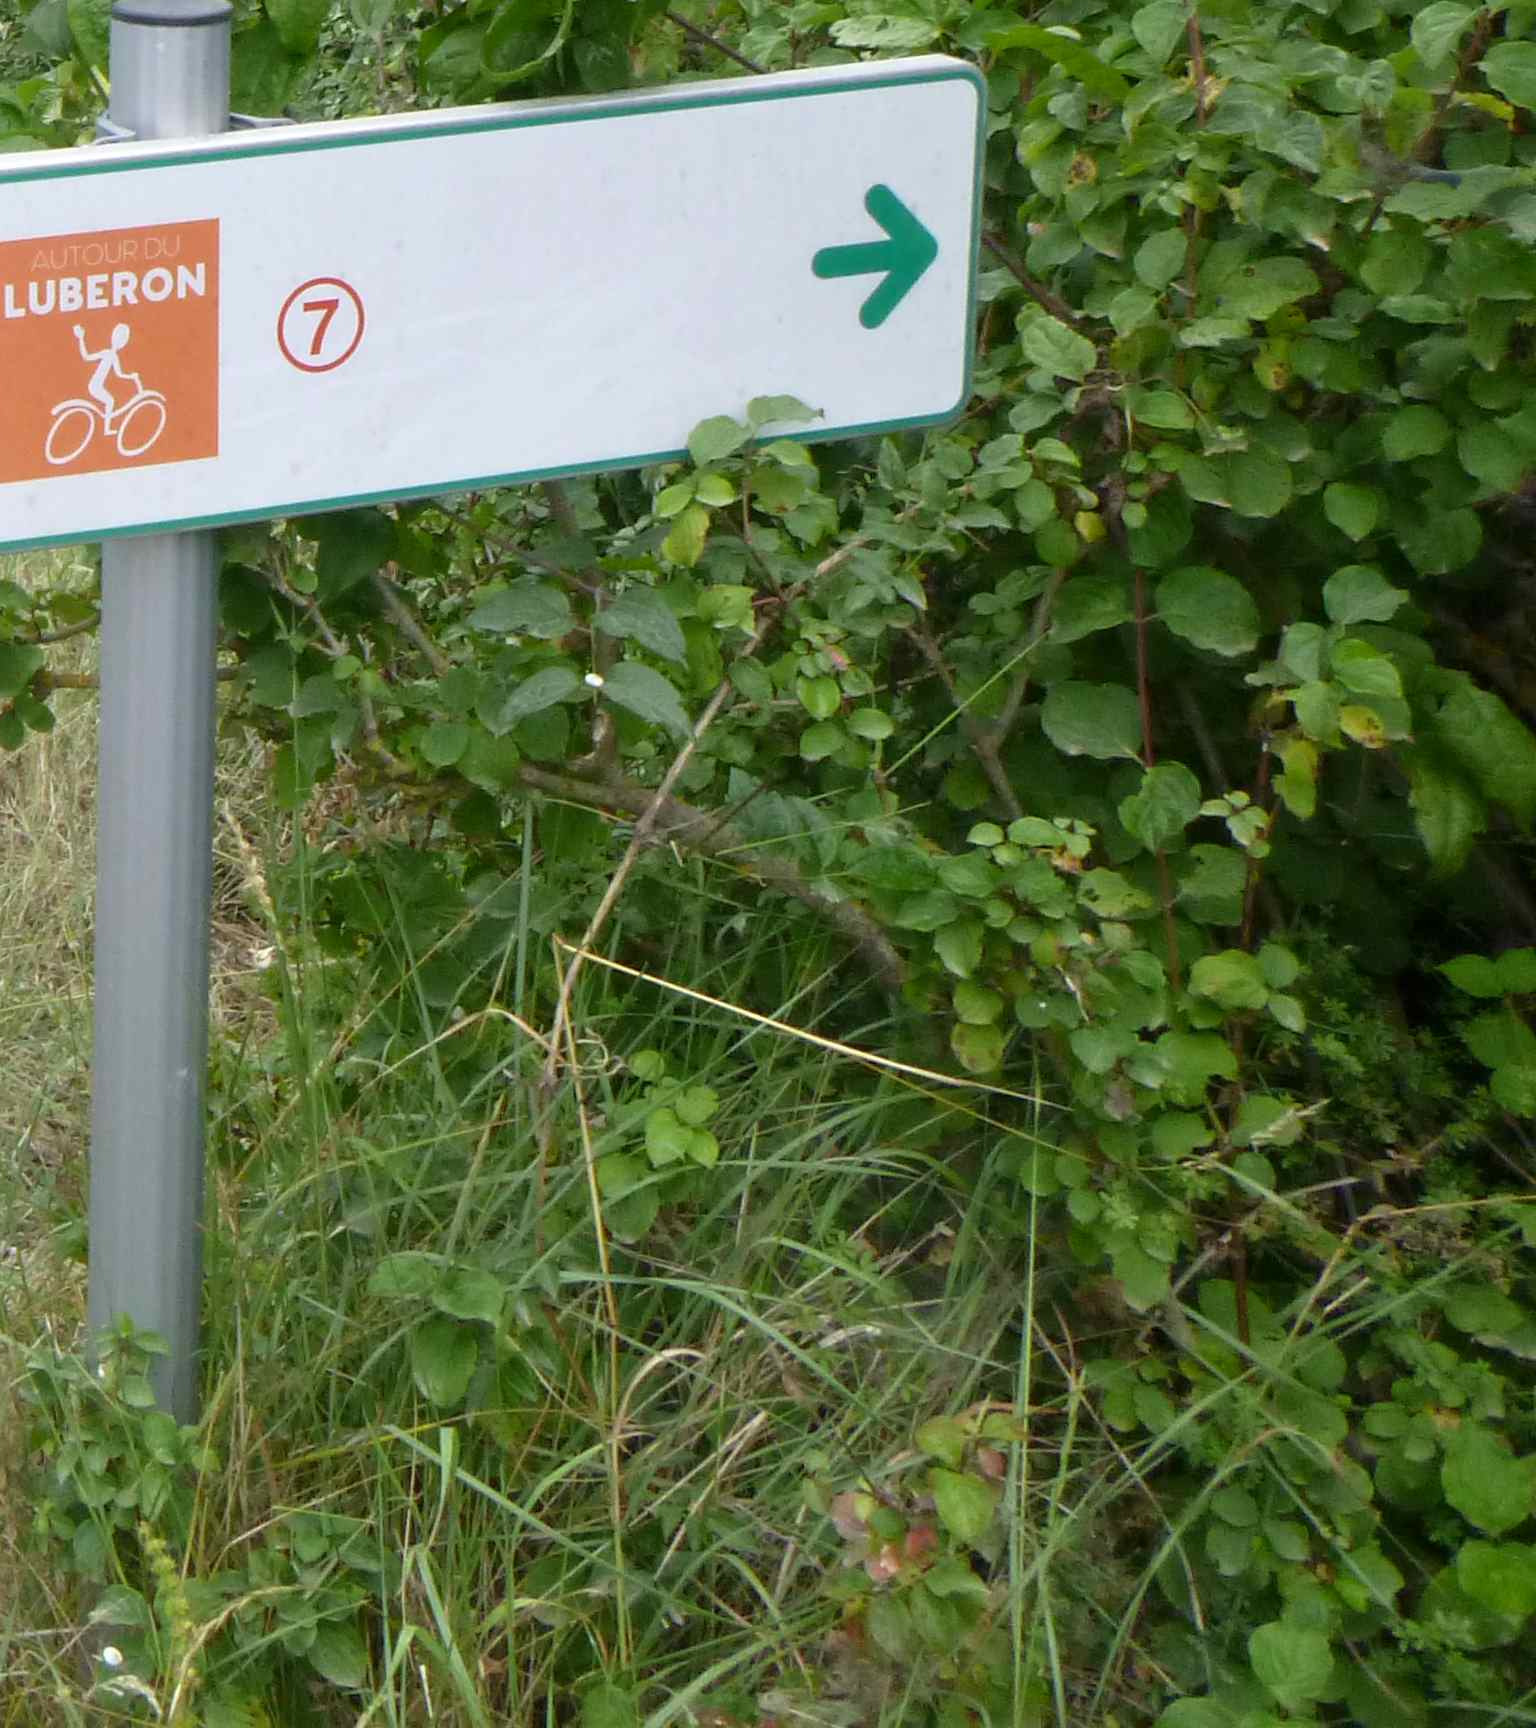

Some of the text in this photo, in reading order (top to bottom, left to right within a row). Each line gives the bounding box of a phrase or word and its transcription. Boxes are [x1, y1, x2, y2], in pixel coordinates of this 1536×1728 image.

[30, 234, 181, 272] AUTOUR DU
[3, 262, 206, 319] LUBERON
[301, 297, 340, 357] 7
